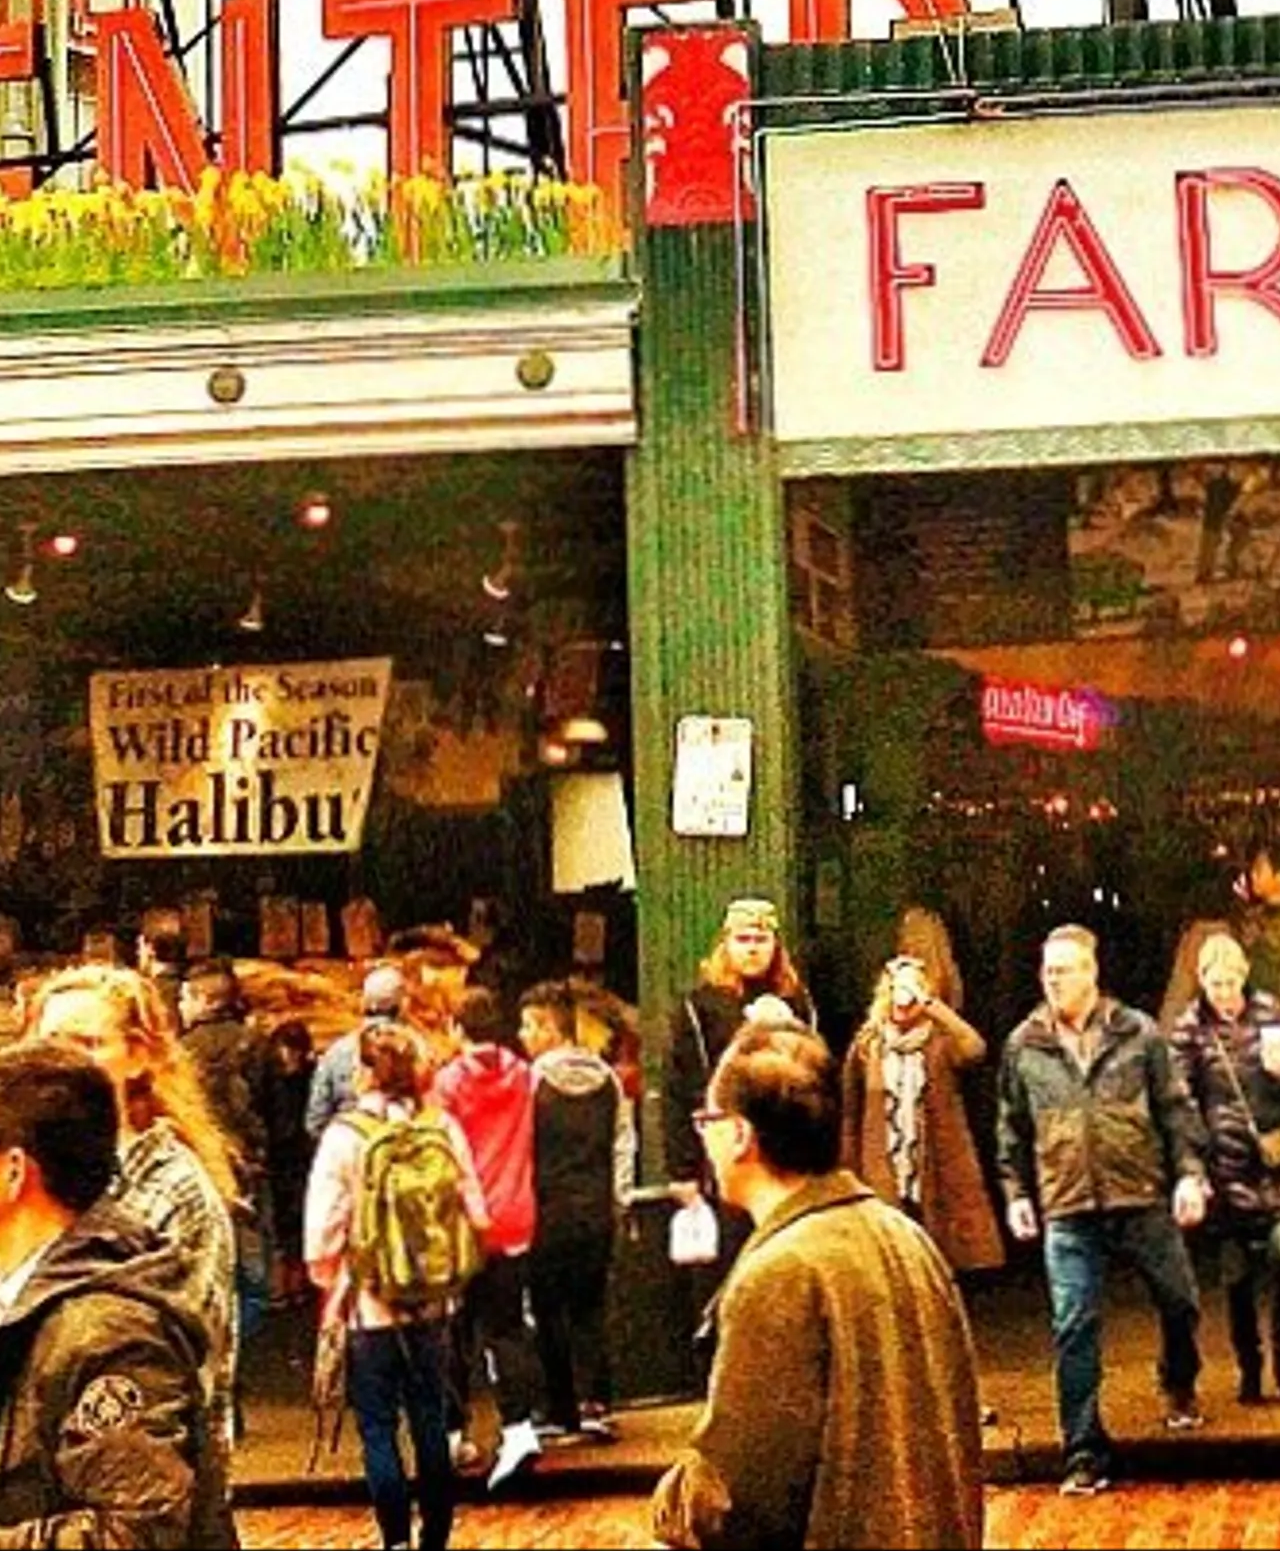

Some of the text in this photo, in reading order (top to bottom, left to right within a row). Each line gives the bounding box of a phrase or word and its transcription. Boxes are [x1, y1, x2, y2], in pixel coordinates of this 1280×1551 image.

[108, 671, 378, 711] First of the Season
[107, 710, 379, 765] Wild Pacific
[104, 768, 363, 848] Halibu
